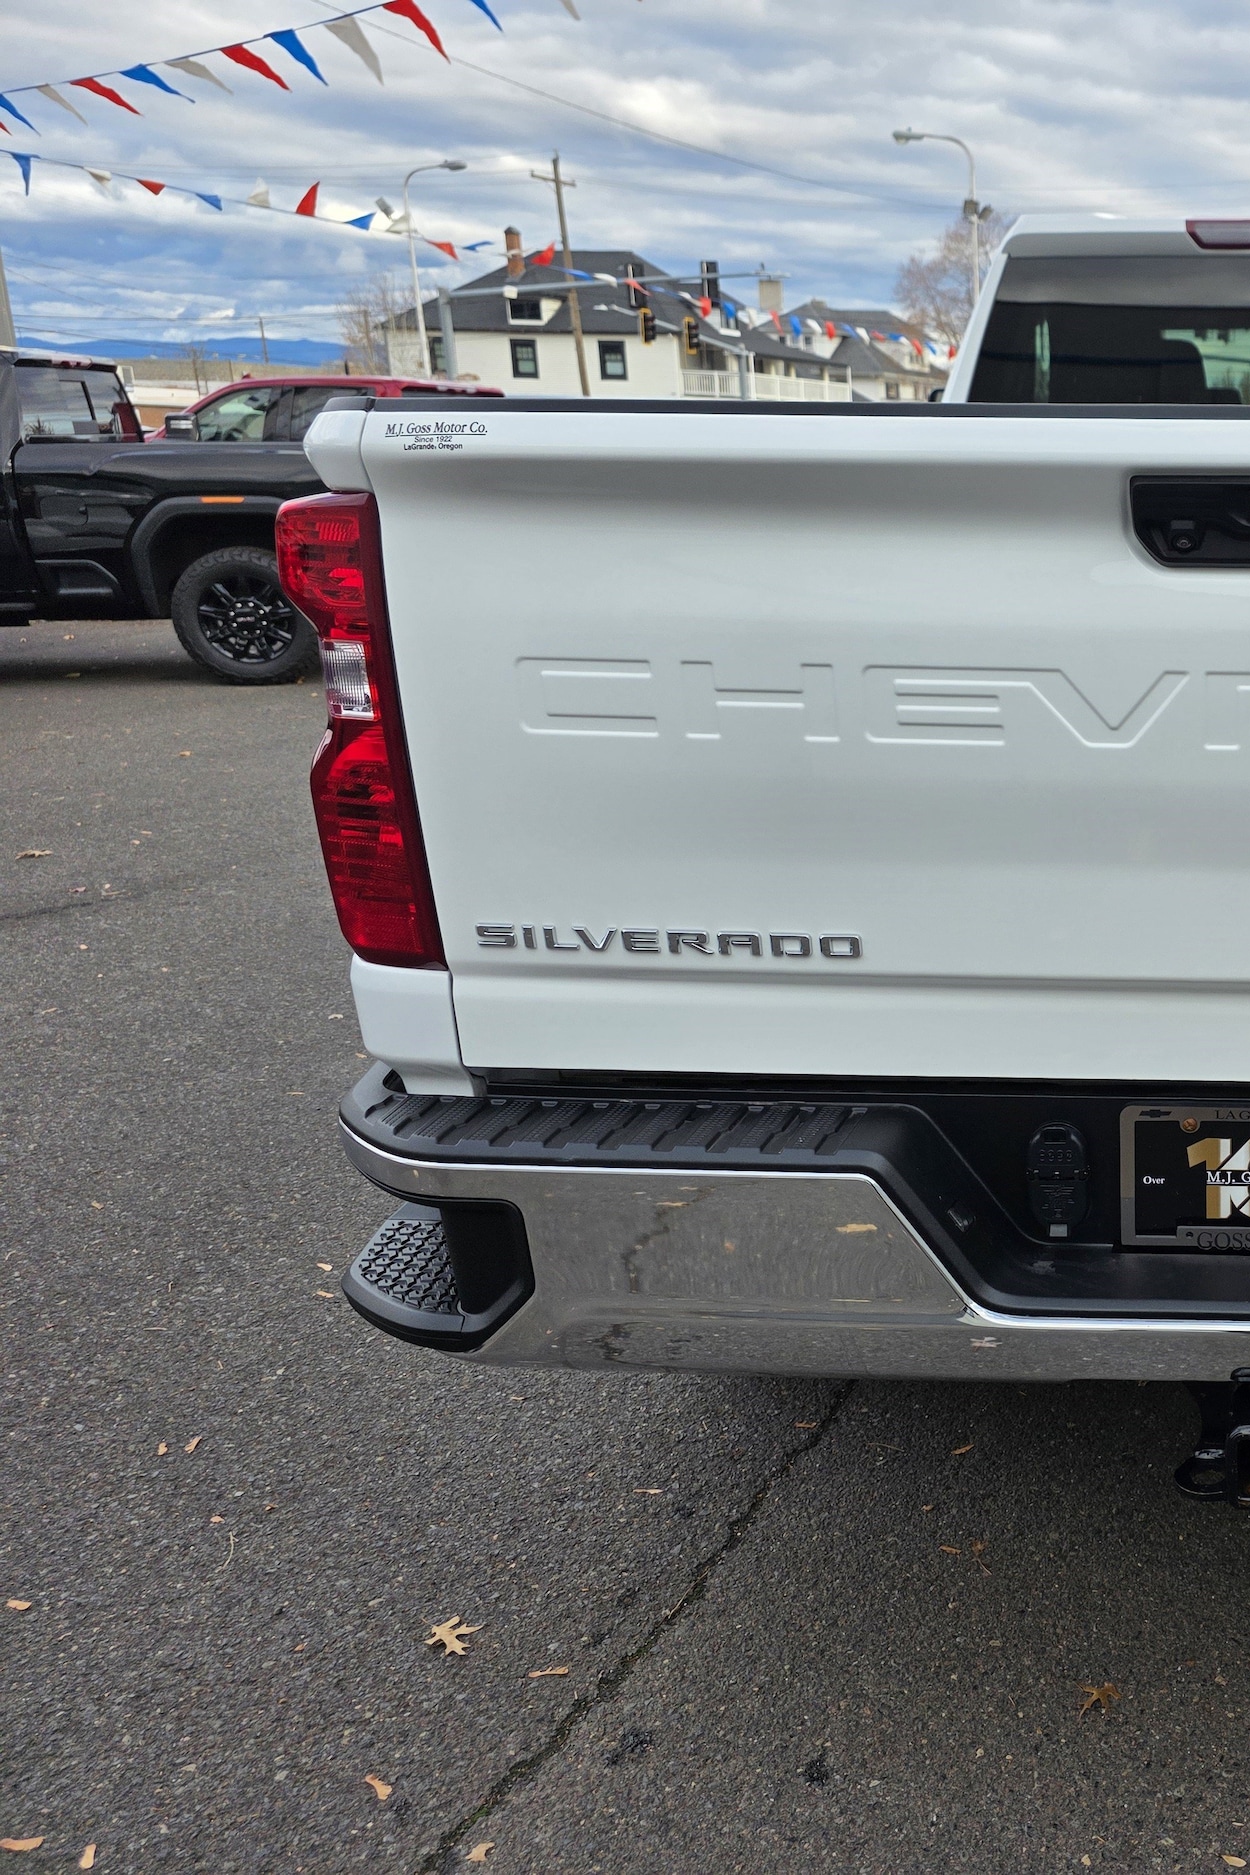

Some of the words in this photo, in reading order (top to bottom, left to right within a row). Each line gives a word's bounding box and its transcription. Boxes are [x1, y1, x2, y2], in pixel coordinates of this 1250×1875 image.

[385, 424, 404, 437] M.J.
[406, 423, 431, 434] Goss
[433, 422, 467, 433] Motor
[469, 421, 488, 433] Co.
[436, 435, 453, 443] 1922
[438, 442, 463, 450] Oregon
[475, 922, 864, 959] SILVERADO
[1142, 1175, 1166, 1185] Over
[1206, 1171, 1236, 1184] M.J.
